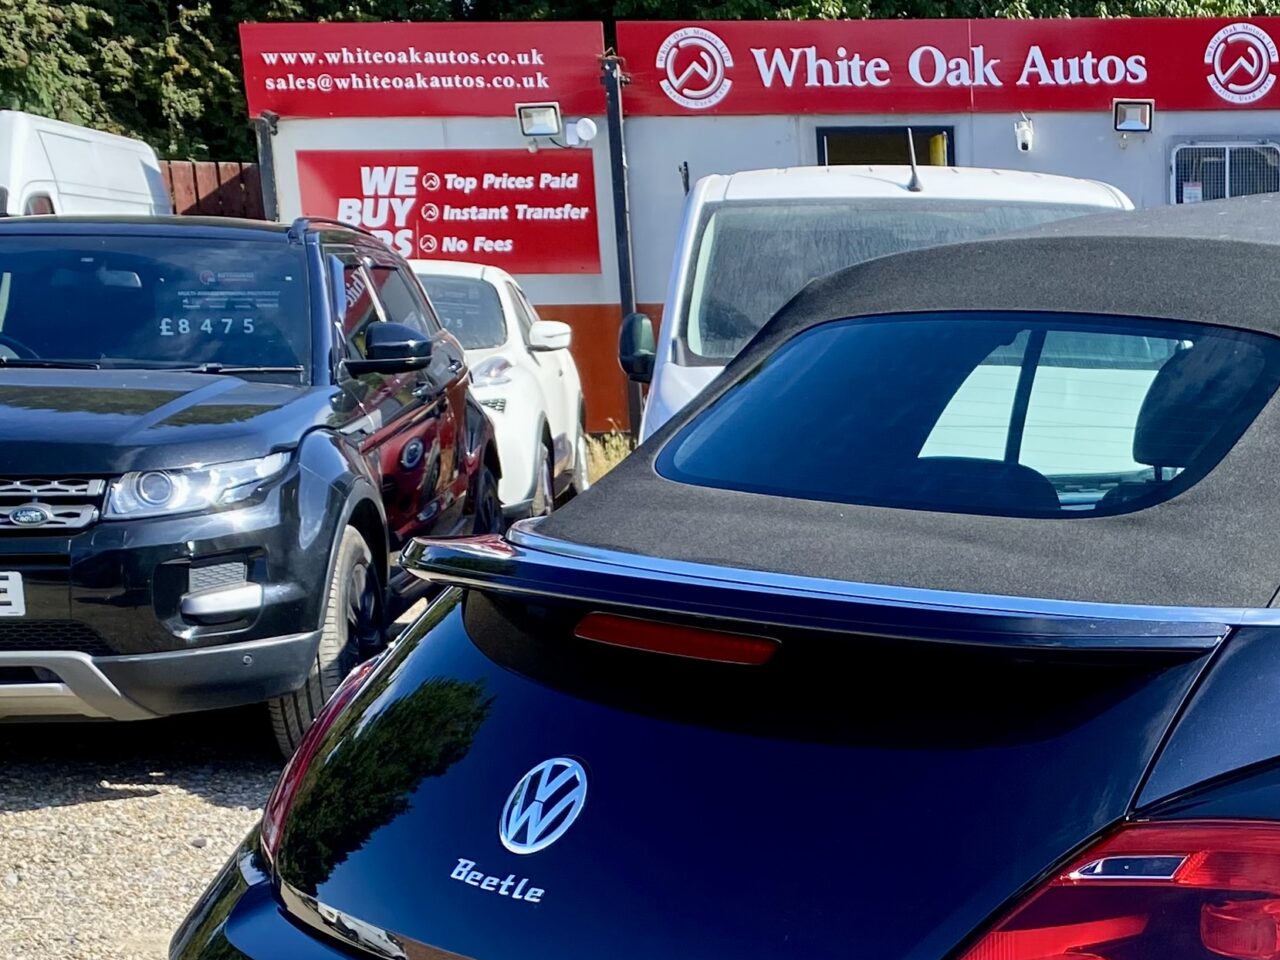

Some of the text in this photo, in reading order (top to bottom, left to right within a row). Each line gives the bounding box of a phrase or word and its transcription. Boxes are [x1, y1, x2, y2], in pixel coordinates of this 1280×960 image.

[1222, 25, 1237, 35] Oak
[260, 47, 545, 66] www.whiteoakautos.co.uk
[750, 45, 1148, 88] White Oak Autos
[265, 72, 550, 92] sales@whiteoakautos.co.uk
[360, 166, 419, 196] WE
[444, 172, 579, 194] Top Prices Paid
[337, 198, 416, 227] BUY
[443, 203, 589, 221] Instant Transfer
[441, 236, 514, 252] No Fees
[450, 857, 546, 903] Beetle
